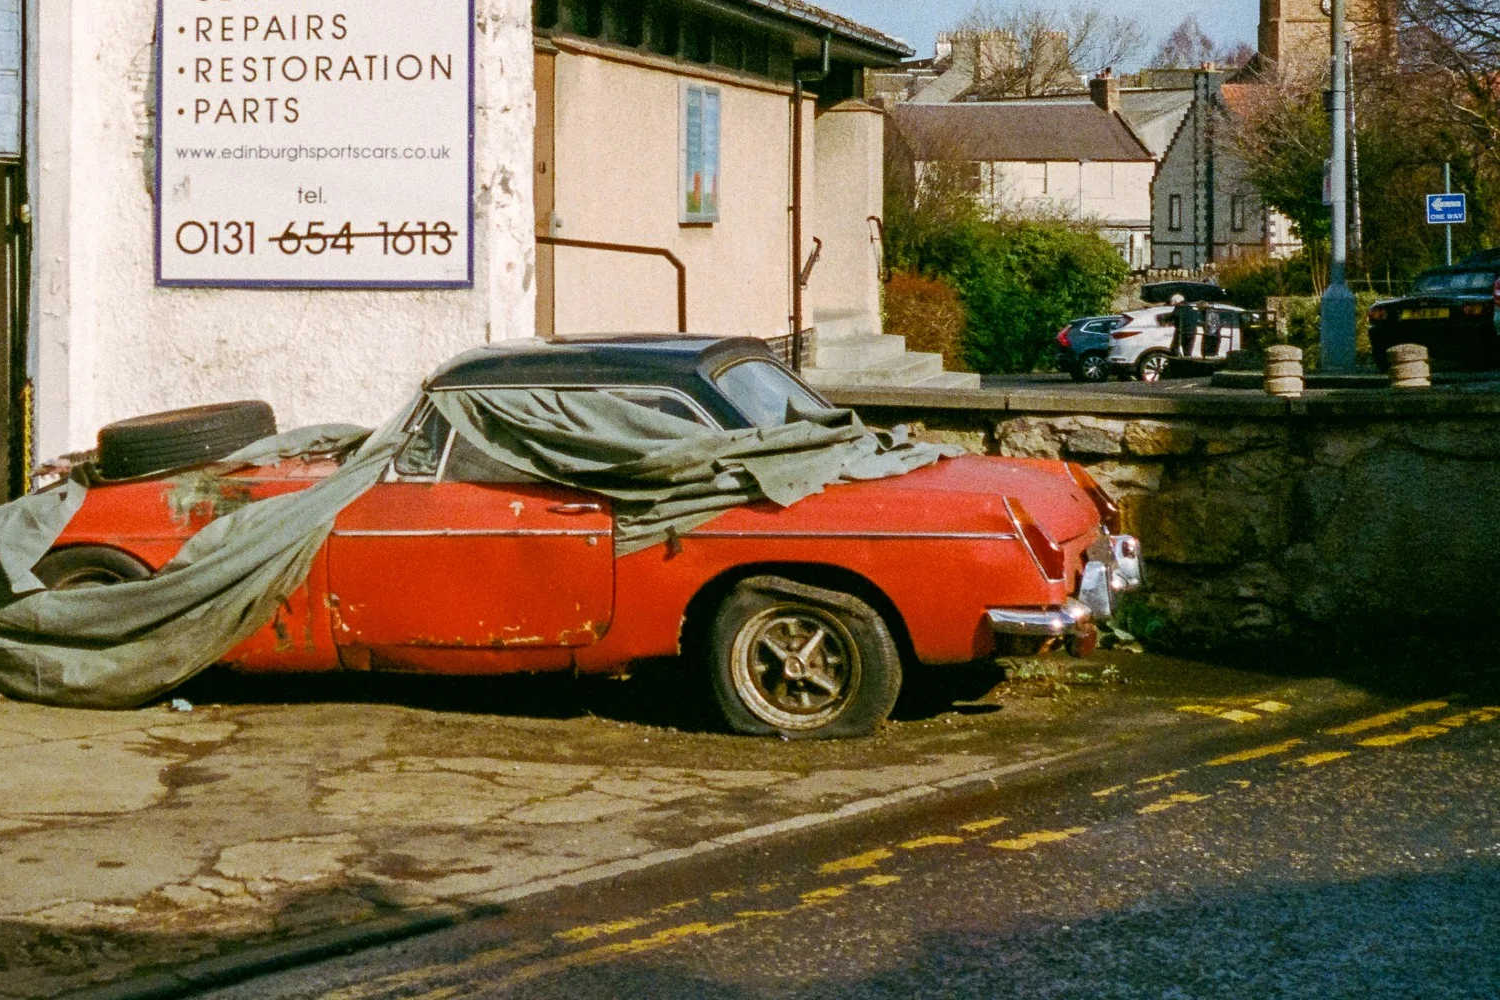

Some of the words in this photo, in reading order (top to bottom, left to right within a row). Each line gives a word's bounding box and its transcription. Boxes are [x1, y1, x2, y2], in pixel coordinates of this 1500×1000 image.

[195, 13, 348, 43] REPAIRS
[195, 53, 453, 83] RESTORATION
[194, 97, 300, 124] PARTS
[175, 143, 450, 162] www.edinburghsportscars.co.uk
[297, 185, 328, 205] tel.
[1446, 212, 1463, 220] WAY
[175, 220, 255, 255] 0131
[276, 221, 355, 255] 654
[377, 221, 453, 255] 1613
